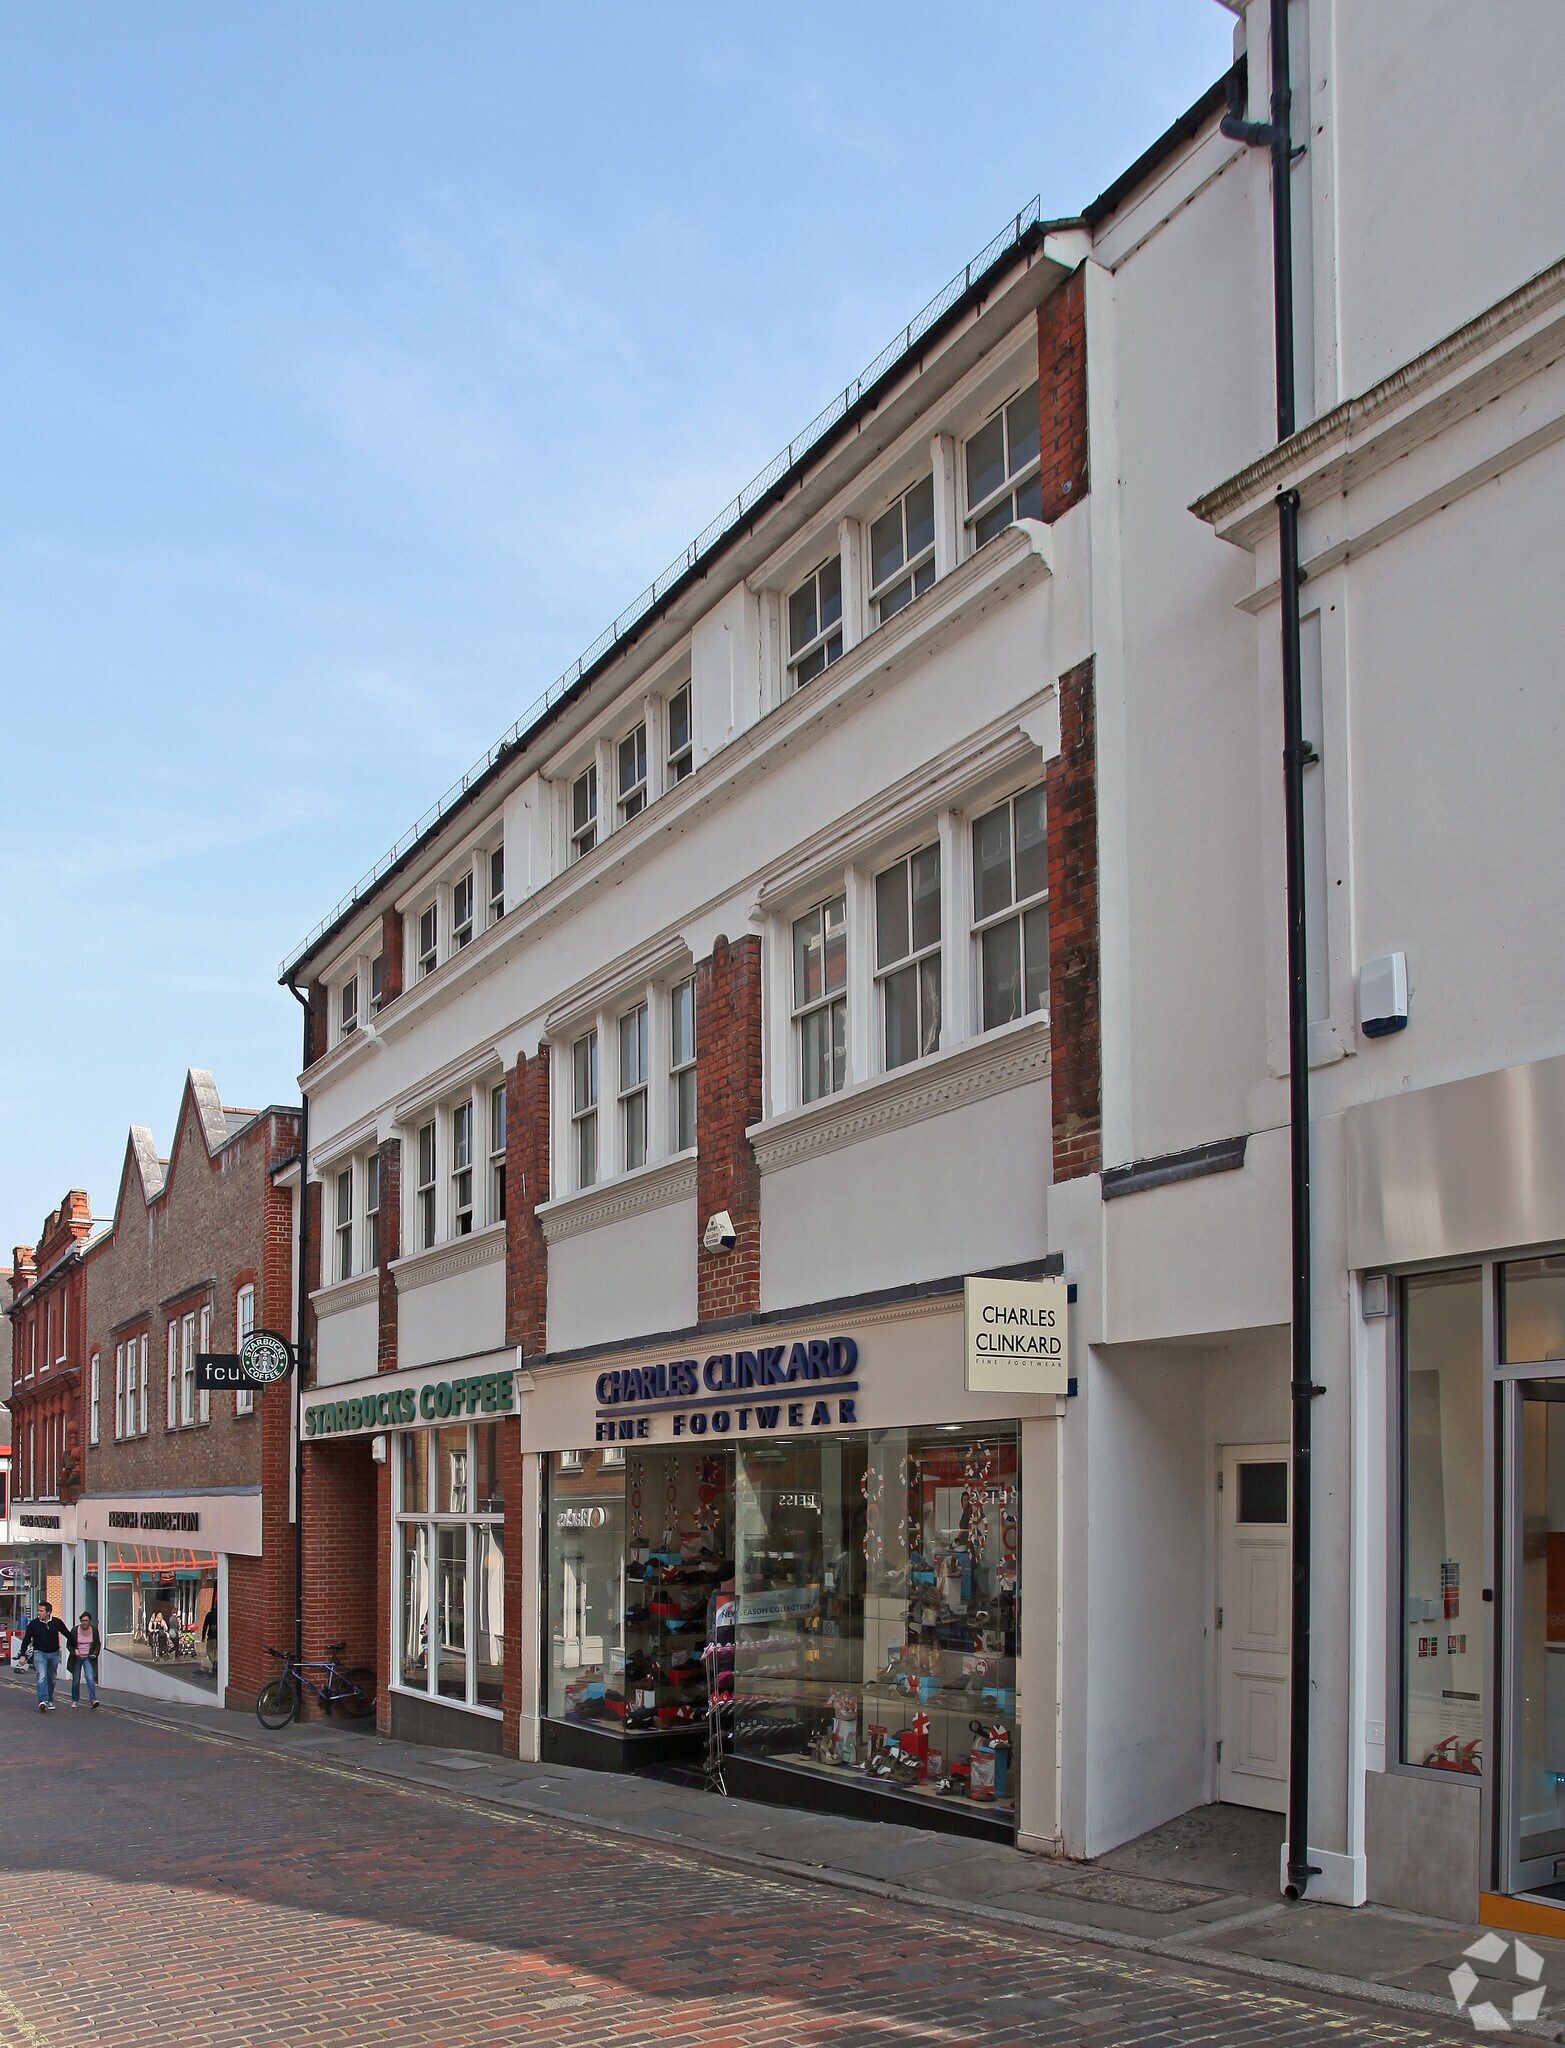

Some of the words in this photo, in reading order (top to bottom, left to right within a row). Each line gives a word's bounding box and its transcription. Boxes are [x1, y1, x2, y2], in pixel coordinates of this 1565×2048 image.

[983, 1306, 1055, 1327] CHARLES
[245, 1338, 286, 1360] STARBUCKS
[976, 1333, 1061, 1354] CLINKARD
[205, 1363, 246, 1380] fcu
[248, 1367, 281, 1380] COFFEE
[596, 1359, 698, 1404] CHARLES
[703, 1337, 858, 1391] CLINKARD
[1008, 1360, 1062, 1368] FOOTWEAR
[305, 1388, 416, 1436] STARBUCKS
[420, 1371, 513, 1420] COFFEE
[596, 1418, 649, 1441] FINE
[673, 1399, 858, 1436] FOOTWEAR
[740, 1607, 768, 1616] SEASON
